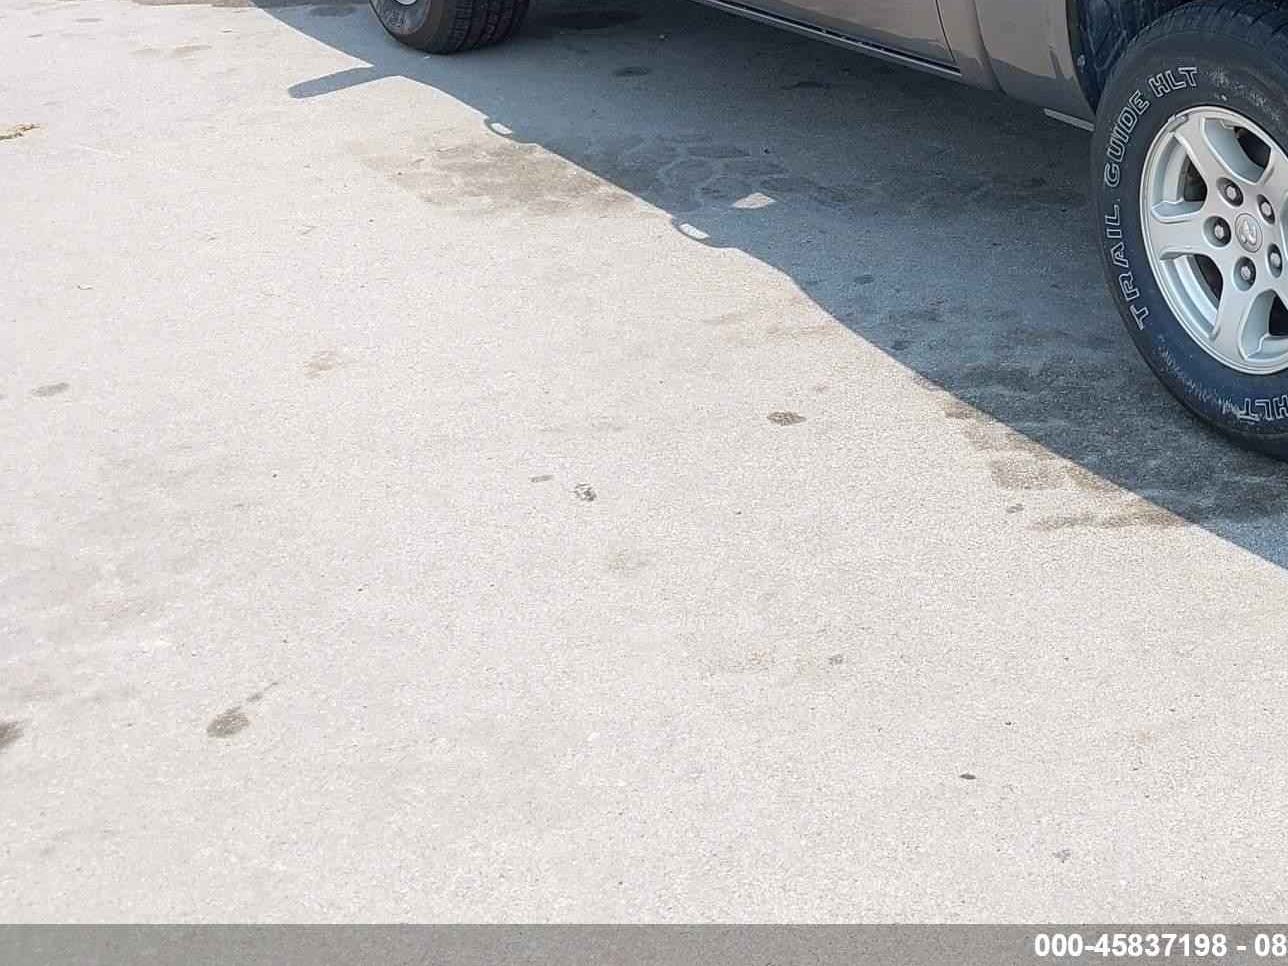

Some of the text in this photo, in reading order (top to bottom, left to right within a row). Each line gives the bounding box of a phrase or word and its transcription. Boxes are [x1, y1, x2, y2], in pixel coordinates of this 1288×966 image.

[1104, 66, 1200, 332] TRAIL GUIDE HLT
